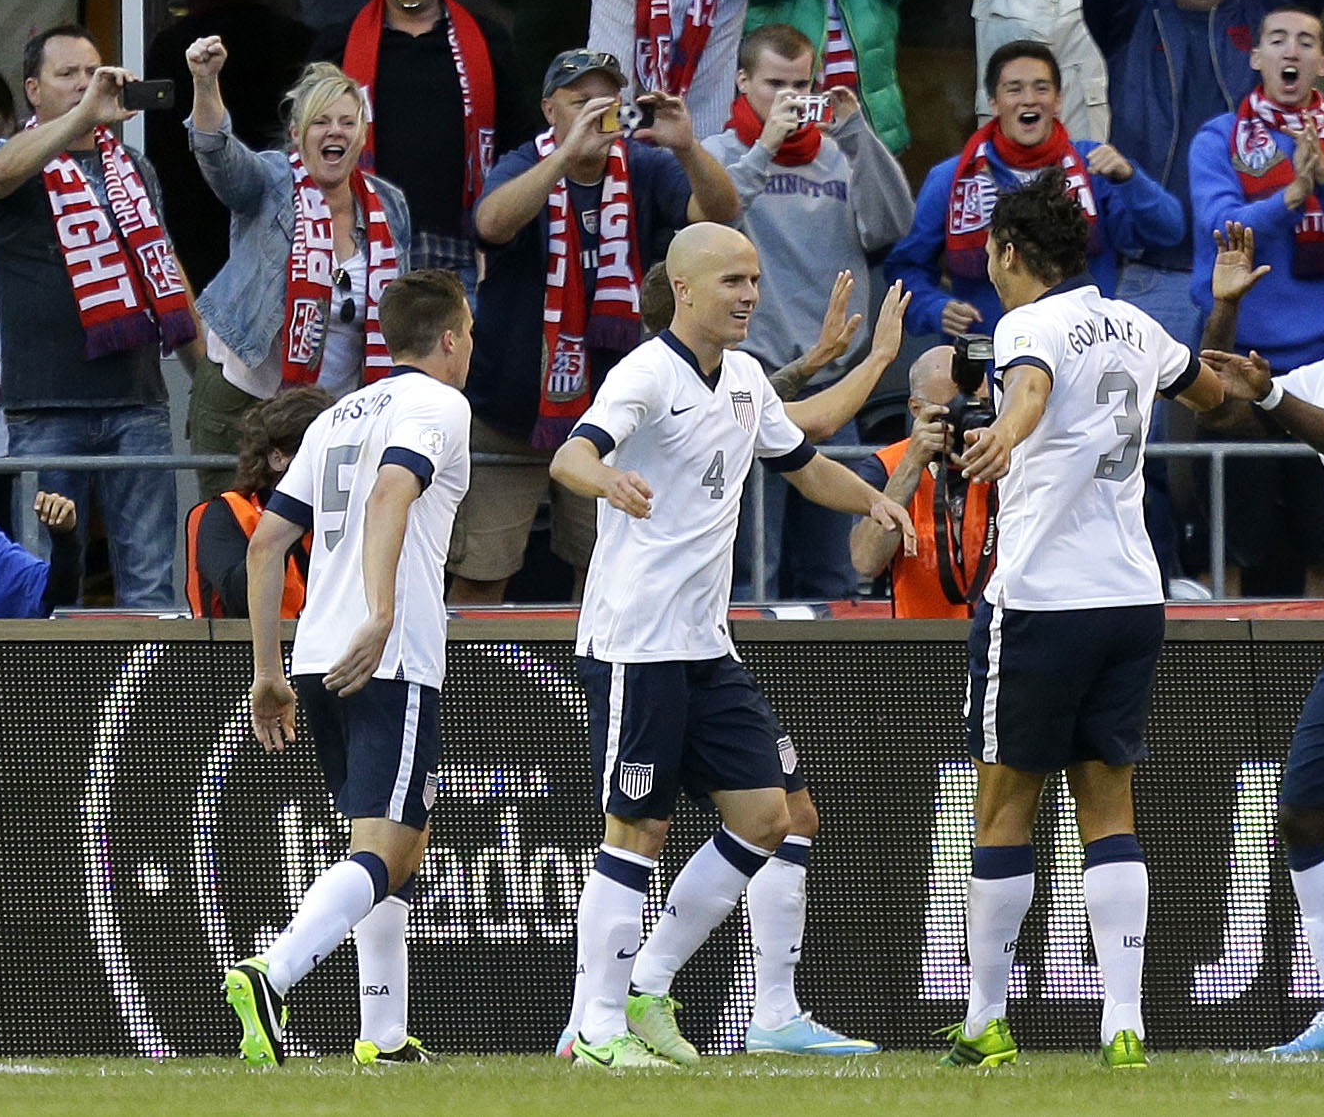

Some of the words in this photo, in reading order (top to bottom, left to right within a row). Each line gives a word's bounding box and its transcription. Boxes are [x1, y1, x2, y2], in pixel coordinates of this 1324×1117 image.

[42, 156, 138, 312] FIGHT
[701, 450, 725, 500] 4
[1093, 372, 1144, 483] 3
[321, 440, 365, 553] 5
[361, 984, 390, 996] USA
